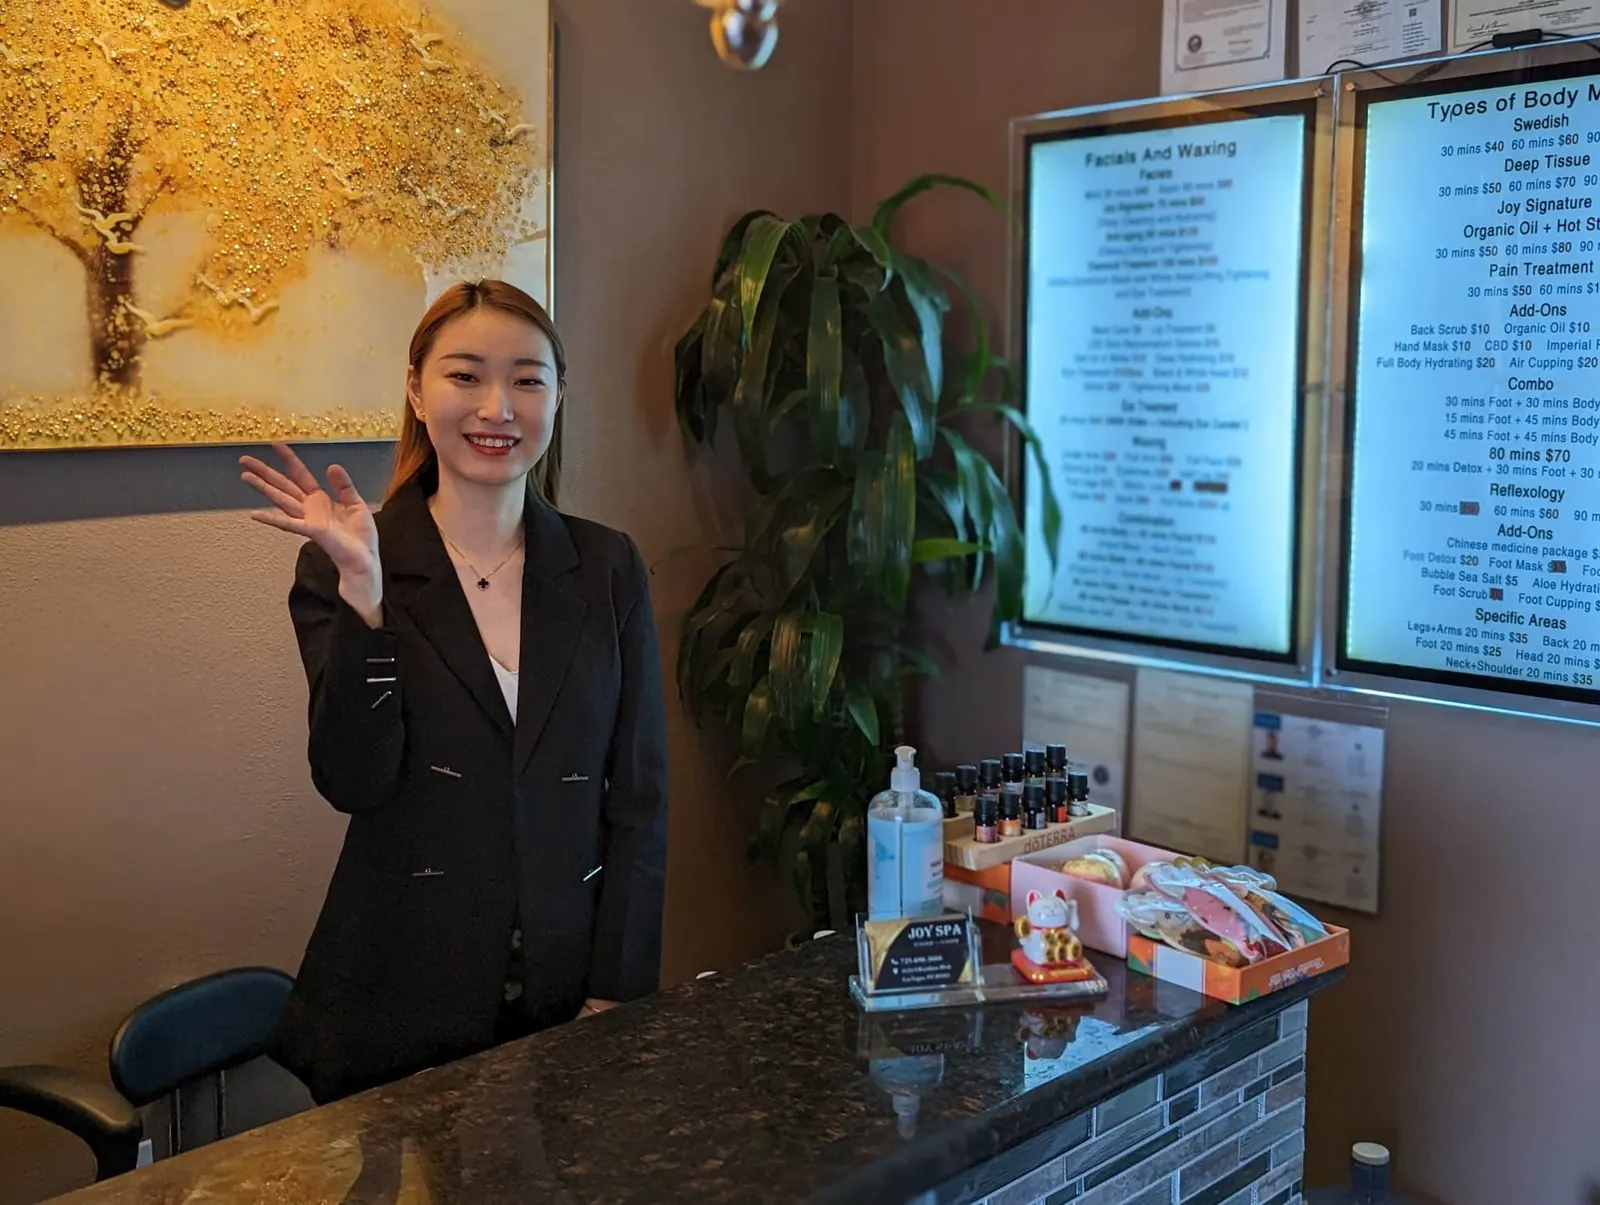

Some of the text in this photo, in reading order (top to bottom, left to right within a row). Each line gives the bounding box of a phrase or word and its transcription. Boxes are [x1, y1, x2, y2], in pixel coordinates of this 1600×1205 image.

[1427, 100, 1487, 123] Types
[1496, 92, 1516, 112] of
[1524, 87, 1579, 110] Body
[1513, 114, 1569, 132] Swedish
[1440, 146, 1454, 157] 30
[1457, 143, 1481, 156] mins
[1484, 140, 1504, 154] $40
[1511, 139, 1525, 151] 60
[1528, 136, 1554, 149] mins
[1557, 133, 1579, 147] $60
[1085, 141, 1237, 168] Facials And Waxing
[1504, 154, 1590, 173] Deep Tissue
[1438, 174, 1598, 197] 30 mins $50 60 mins $70 90
[1497, 196, 1592, 217] Joy Signature
[1463, 224, 1515, 241] Organic
[1519, 221, 1538, 235] Oil
[1556, 219, 1581, 233] Hot
[1435, 240, 1594, 259] 30 mins $50 60 mins $80 90
[1489, 260, 1594, 277] Pain Treatment
[1467, 286, 1481, 297] 30
[1484, 285, 1508, 297] mins
[1512, 284, 1532, 297] $50
[1539, 284, 1553, 295] 60
[1556, 282, 1583, 295] mins
[1509, 301, 1567, 318] Add-Ons
[1410, 321, 1590, 337] Back Scrub $10 Organic Oil $10
[1394, 339, 1592, 353] Hand Mask $10 CBD $10 Imperial
[1476, 356, 1495, 369] $20
[1509, 357, 1525, 369] Air
[1528, 356, 1574, 371] Cupping
[1577, 356, 1598, 369] $20
[1508, 377, 1554, 391] Combo
[1461, 396, 1485, 408] mins
[1489, 397, 1513, 408] Foot
[1526, 397, 1540, 409] 30
[1543, 397, 1569, 409] mins
[1460, 412, 1484, 424] mins
[1487, 414, 1511, 425] Foot
[1524, 414, 1539, 426] 45
[1542, 414, 1568, 426] mins
[1571, 415, 1600, 430] Body
[1459, 429, 1484, 441] mins
[1487, 431, 1510, 442] Foot
[1523, 431, 1538, 443] 45
[1540, 432, 1567, 443] mins
[1570, 432, 1599, 447] Body
[1489, 447, 1571, 463] 80 mins $70
[1453, 461, 1482, 474] Detox
[1496, 464, 1509, 475] 30
[1513, 464, 1538, 477] mins
[1541, 466, 1566, 478] Foot
[1580, 468, 1594, 479] 30
[1489, 483, 1565, 504] Reflexology
[1494, 505, 1507, 517] 60
[1510, 506, 1536, 519] mins
[1538, 508, 1559, 520] $60
[1574, 511, 1588, 522] 90
[1497, 523, 1553, 540] Add-Ons
[1491, 541, 1539, 555] medicine
[1542, 544, 1588, 561] package
[1459, 554, 1479, 566] $20
[1489, 557, 1513, 569] Foot
[1515, 559, 1544, 572] Mask
[1458, 571, 1478, 583] Sea
[1481, 572, 1502, 584] Salt
[1504, 575, 1518, 587] $5
[1532, 577, 1557, 590] Aloe
[1458, 587, 1488, 600] Scrub
[1518, 593, 1542, 606] Foot
[1545, 595, 1592, 613] Cupping
[1475, 607, 1567, 630] Specific Areas
[1465, 627, 1478, 639] 20
[1481, 629, 1505, 641] mins
[1508, 632, 1528, 644] $35
[1543, 635, 1569, 649] Back
[1572, 639, 1587, 651] 20
[1455, 641, 1480, 655] mins
[1483, 644, 1502, 657] $25
[1515, 648, 1543, 663] Head
[1546, 653, 1560, 665] 20
[1564, 655, 1590, 669] mins
[1526, 667, 1539, 678] 20
[1543, 669, 1569, 682] mins
[1572, 672, 1593, 685] $35
[907, 923, 962, 940] JOY SPA
